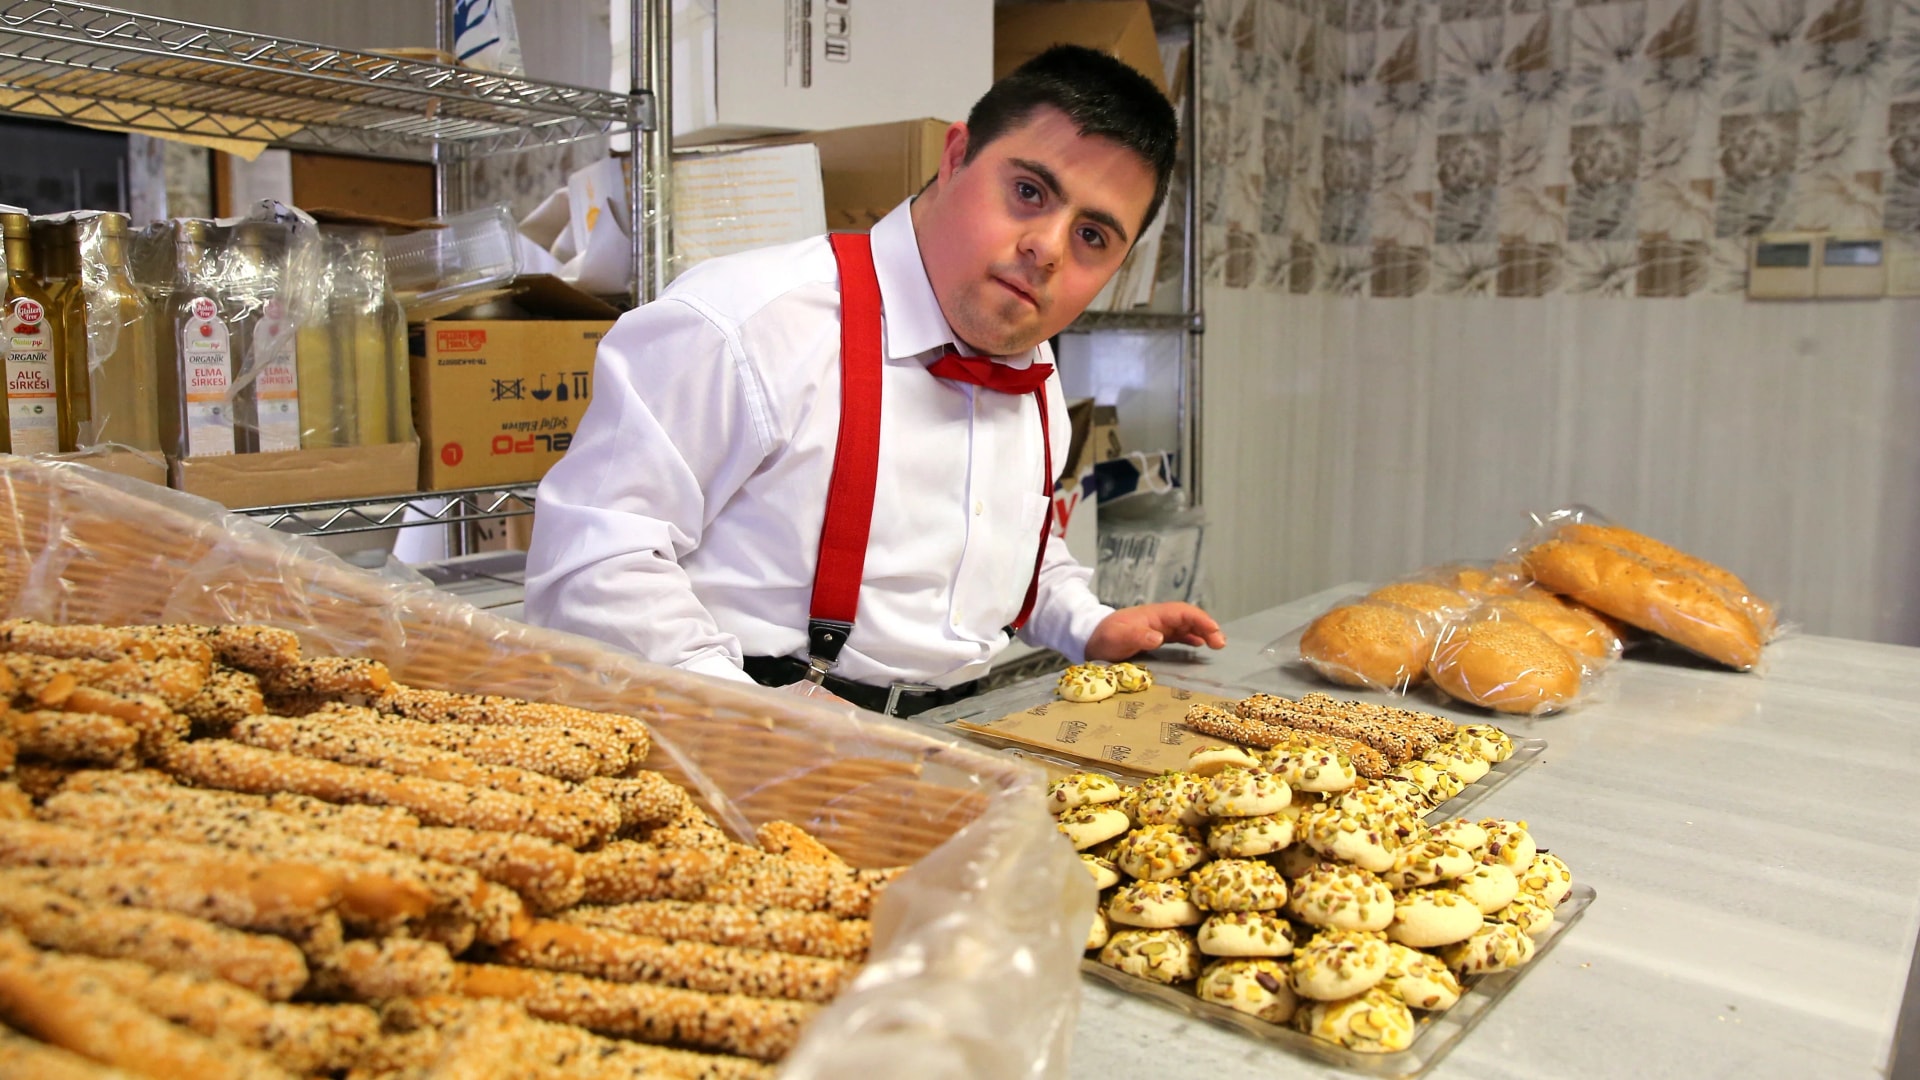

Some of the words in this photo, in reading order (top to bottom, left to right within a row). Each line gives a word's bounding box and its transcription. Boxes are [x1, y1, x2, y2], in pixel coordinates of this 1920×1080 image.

[17, 371, 41, 381] ALIÇ
[195, 368, 222, 377] ELMA
[9, 379, 50, 390] SİRKESİ
[191, 378, 227, 387] SİRKESİ
[502, 420, 538, 432] Eldiven
